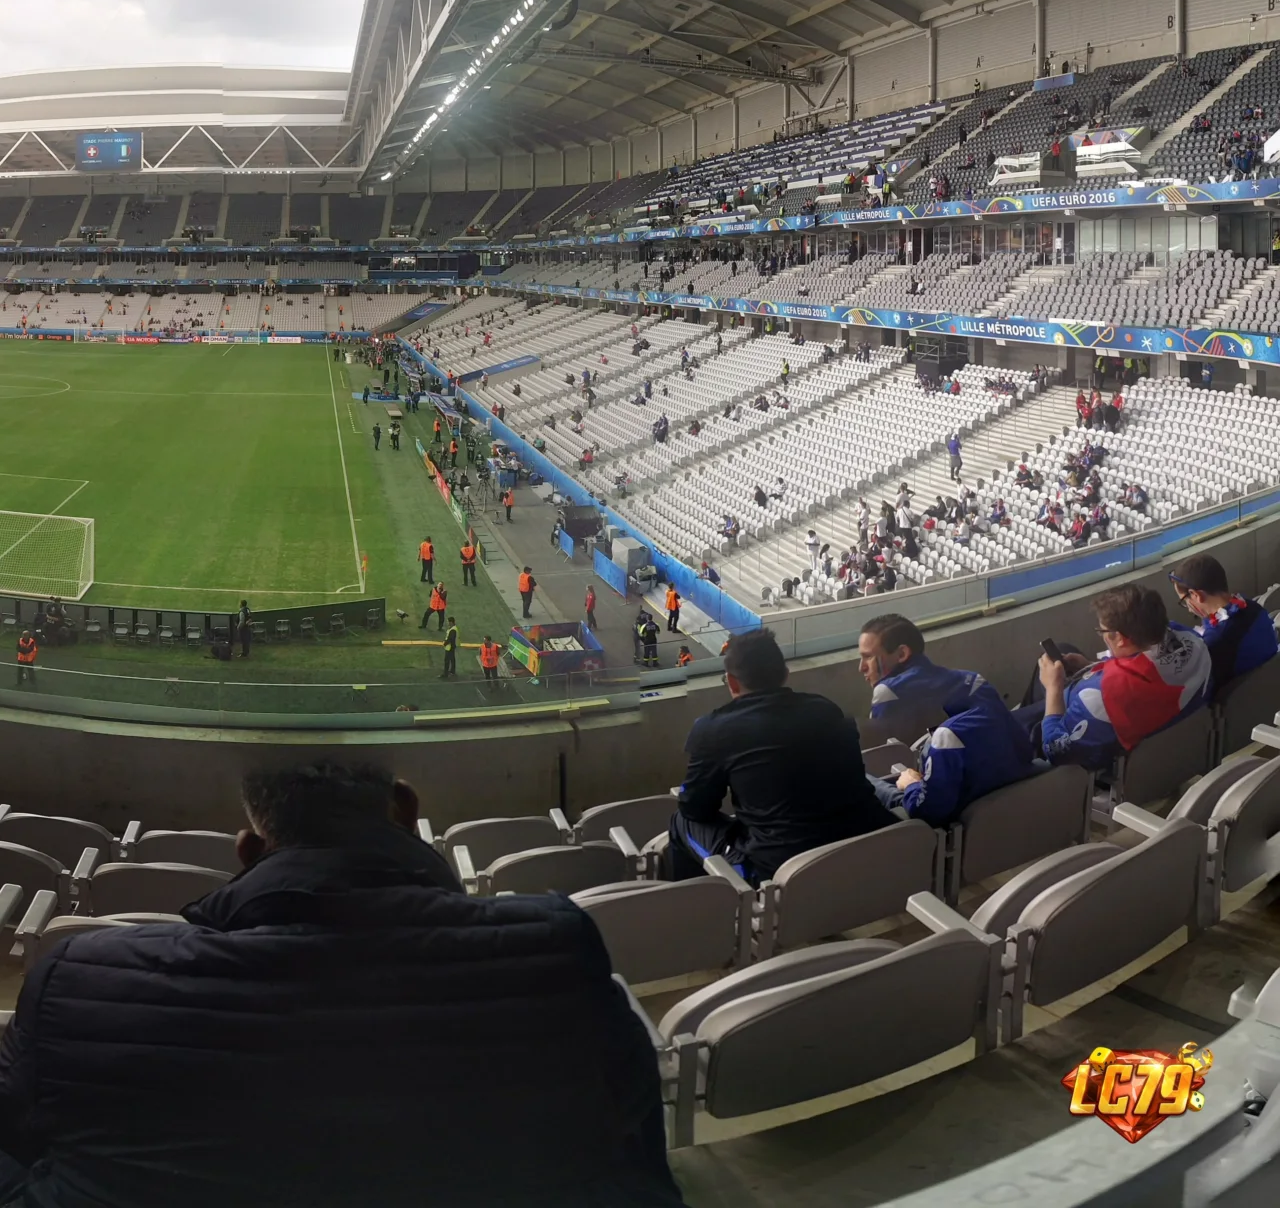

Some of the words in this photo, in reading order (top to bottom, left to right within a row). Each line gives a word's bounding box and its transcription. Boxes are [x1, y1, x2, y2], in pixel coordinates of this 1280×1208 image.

[1032, 196, 1057, 207] UEFA
[1059, 194, 1086, 206] EURO
[1089, 193, 1115, 203] 2016
[841, 212, 856, 221] LILLE
[857, 208, 891, 220] MÉTROPOLE
[782, 305, 797, 314] UEFA
[797, 306, 812, 316] EURO
[812, 308, 827, 318] 2016
[960, 321, 985, 333] LILLE
[986, 321, 1046, 339] MÉTROPOLE
